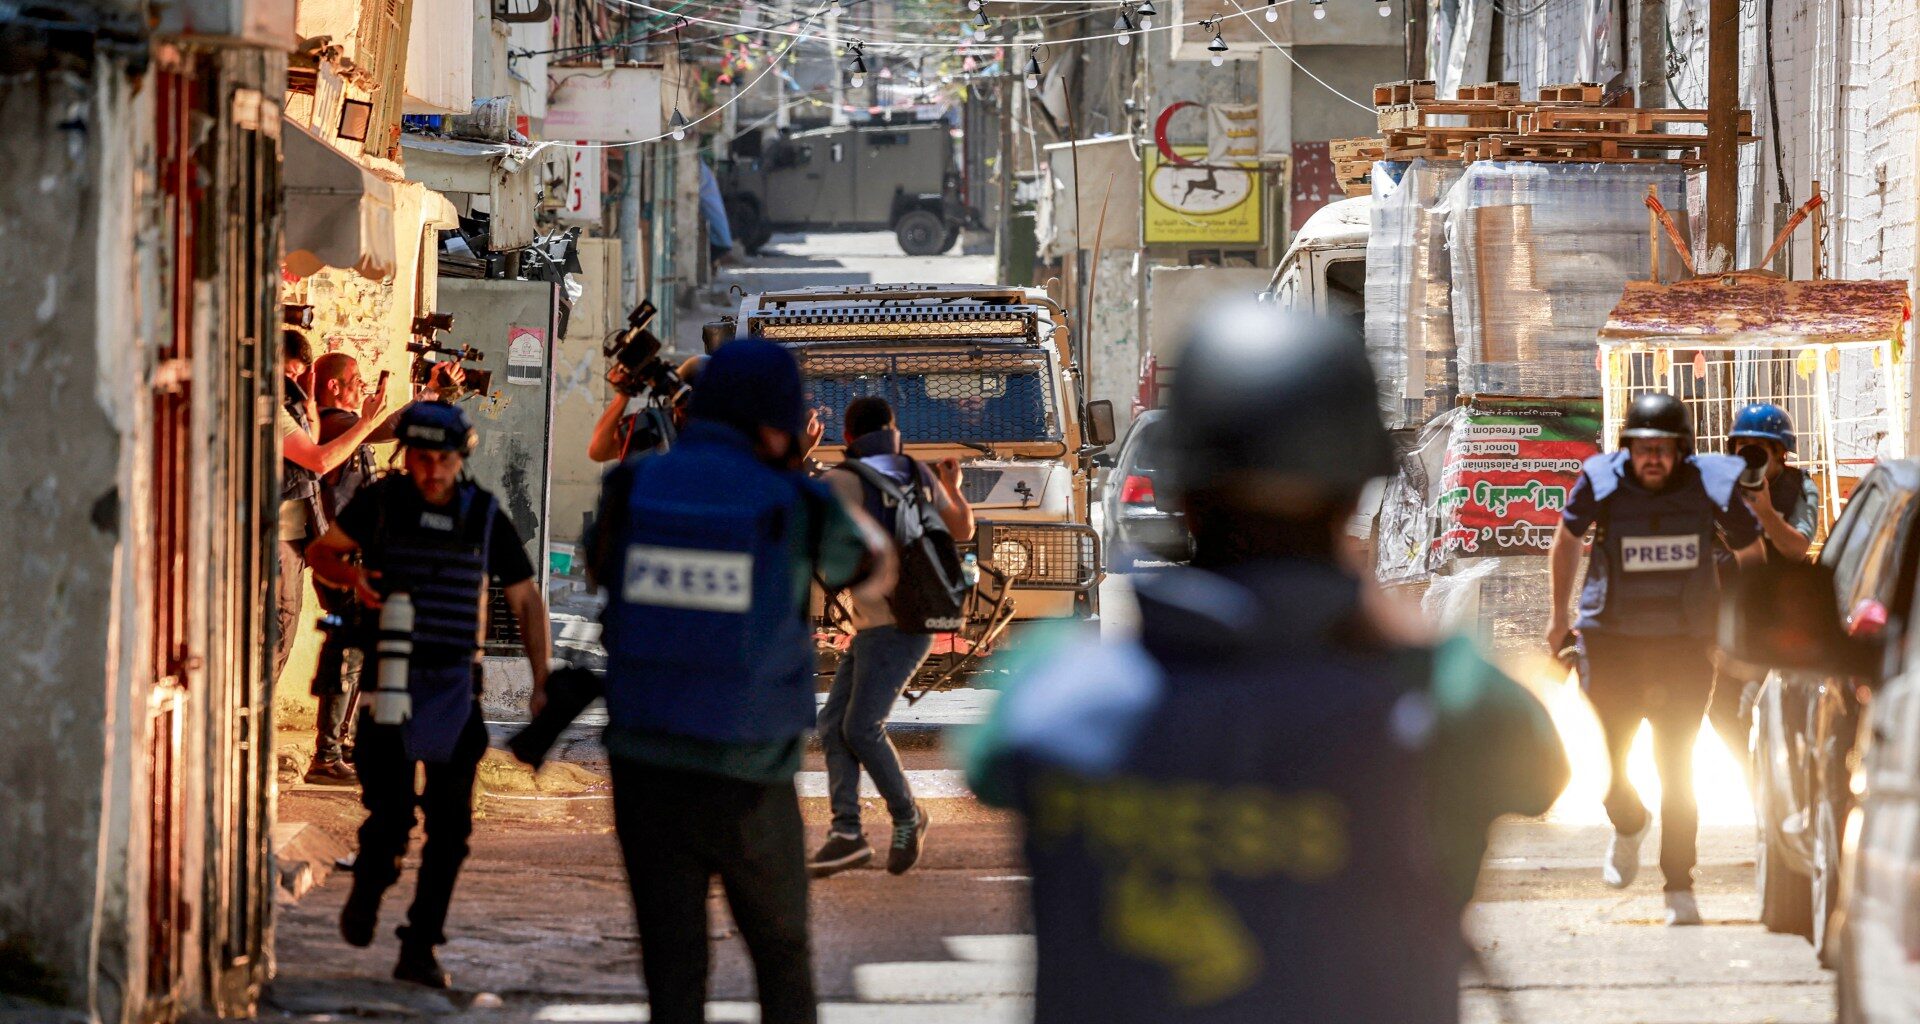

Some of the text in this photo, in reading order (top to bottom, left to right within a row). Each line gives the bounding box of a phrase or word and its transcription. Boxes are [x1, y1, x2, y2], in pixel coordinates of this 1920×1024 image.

[1472, 427, 1516, 437] freedom
[1519, 427, 1539, 437] and
[1473, 443, 1482, 453] is
[1485, 443, 1517, 453] honor
[1462, 460, 1580, 470] Our land is Palestinian
[1624, 543, 1697, 563] PRESS
[628, 557, 741, 594] PRESS
